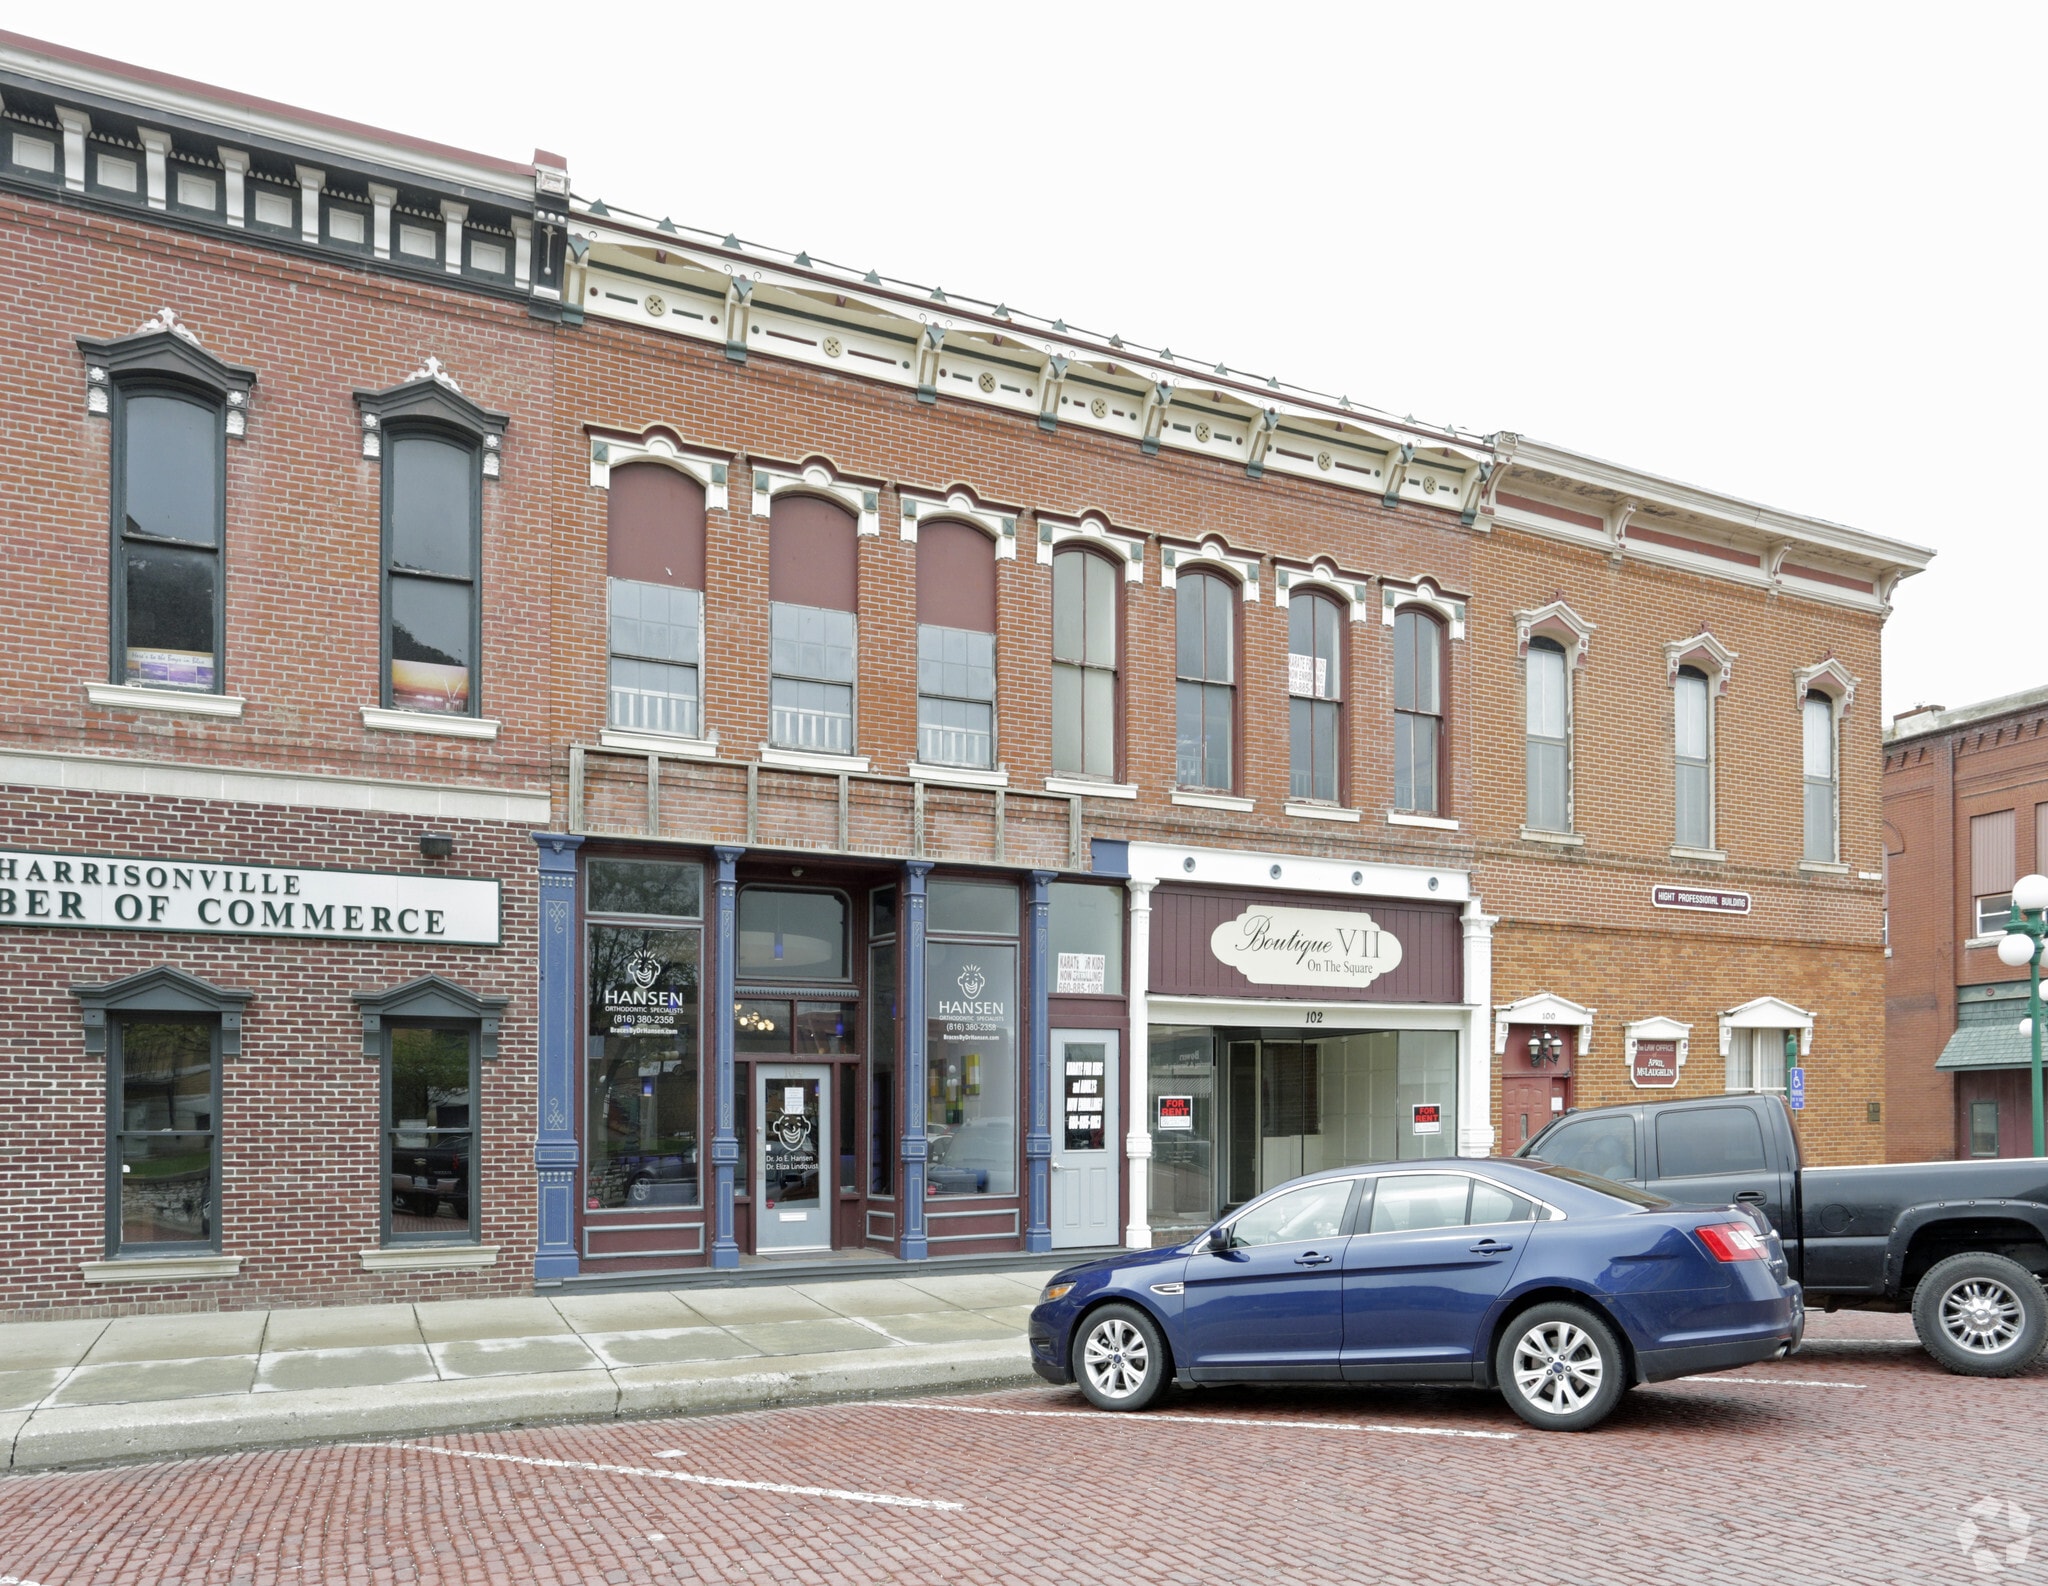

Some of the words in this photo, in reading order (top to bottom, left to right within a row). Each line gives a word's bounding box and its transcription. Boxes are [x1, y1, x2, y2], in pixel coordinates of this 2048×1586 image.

[0, 858, 301, 896] HARRISONVILLE
[1658, 892, 1676, 902] HIGHT
[1678, 893, 1719, 905] PROFESSIONAL
[1721, 896, 1746, 908] BUILDING
[114, 893, 170, 922] OF
[197, 898, 446, 935] COMMERCE
[1235, 914, 1334, 965] Boutique
[1334, 928, 1381, 959] VII
[1307, 958, 1322, 972] On
[1325, 959, 1341, 973] The
[1343, 960, 1373, 976] Square
[605, 990, 683, 1006] HANSEN
[939, 1001, 1004, 1015] HANSEN
[613, 1015, 635, 1025] (816)
[637, 1015, 675, 1024] 380-2358
[1305, 1011, 1323, 1023] 102
[1542, 1012, 1556, 1020] 100
[610, 1027, 678, 1035] BracesByDrHansen.com
[946, 1022, 965, 1032] (816)
[965, 1023, 997, 1031] 380-2358
[1644, 1044, 1655, 1052] LAW
[1655, 1044, 1675, 1052] OFFICE
[1166, 1099, 1185, 1108] FOR
[1161, 1107, 1190, 1116] RENT
[1419, 1107, 1435, 1115] FOR
[1415, 1114, 1439, 1122] RENT
[791, 1163, 819, 1171] Lindquist
